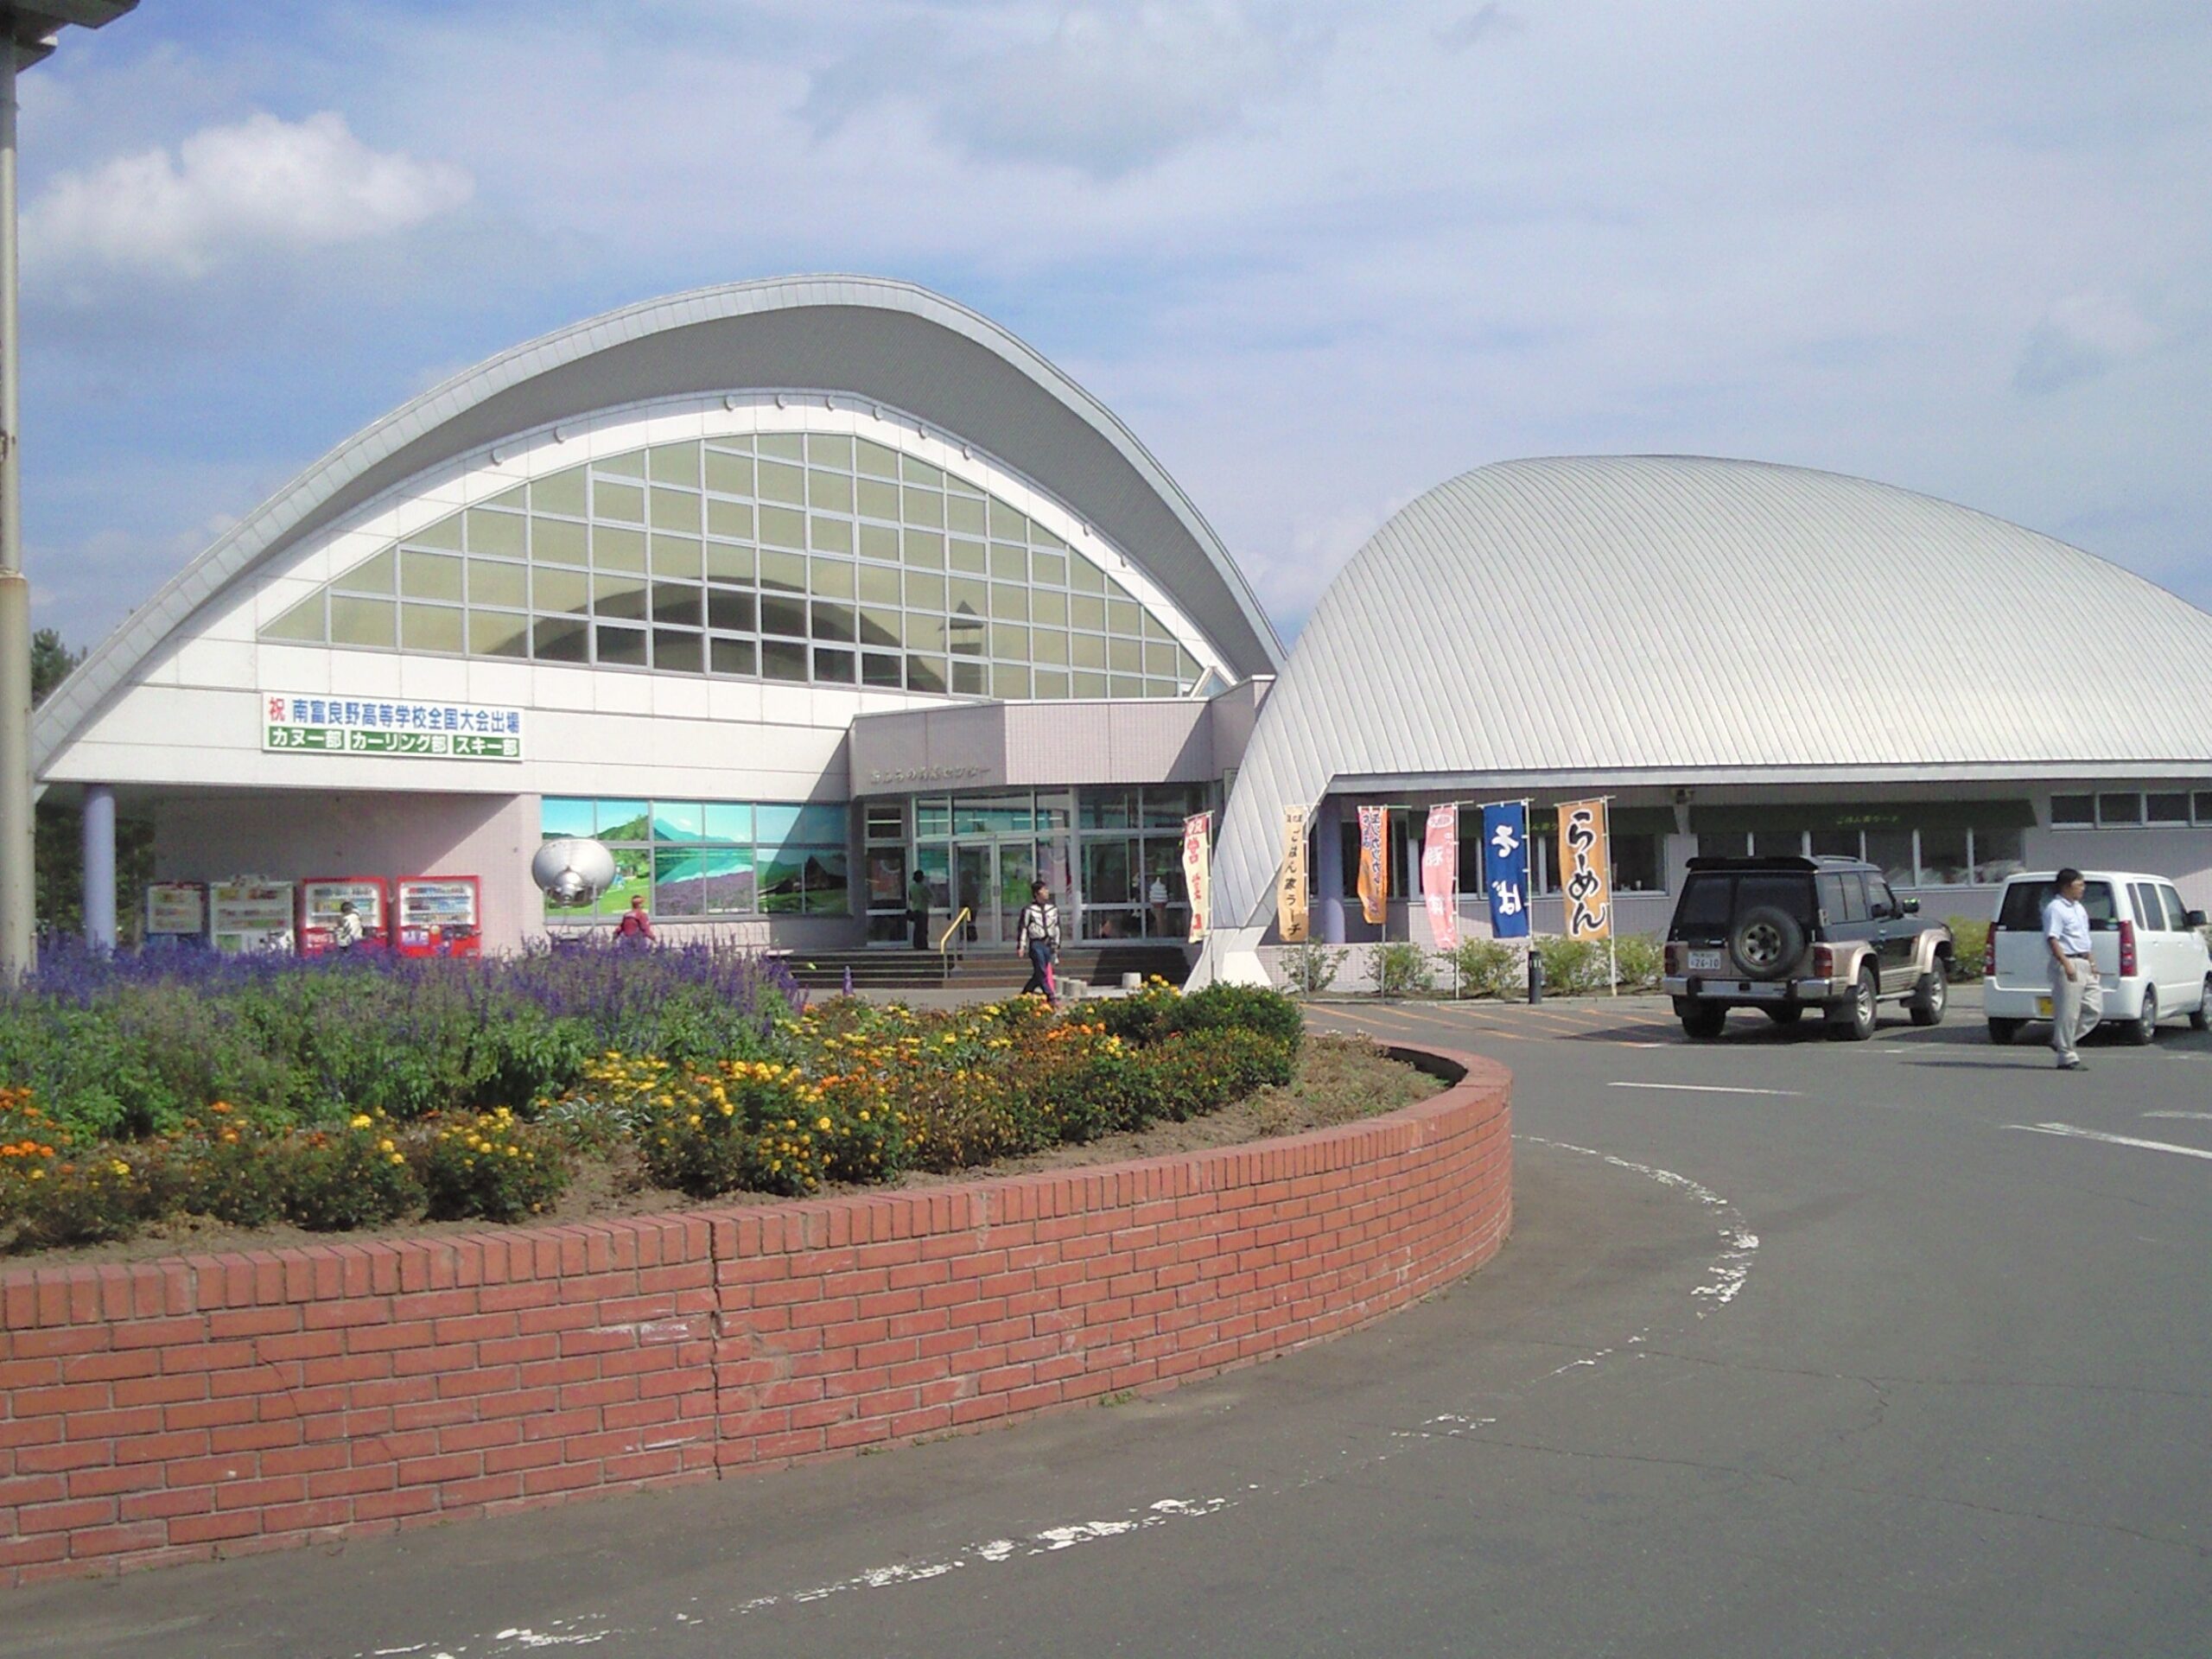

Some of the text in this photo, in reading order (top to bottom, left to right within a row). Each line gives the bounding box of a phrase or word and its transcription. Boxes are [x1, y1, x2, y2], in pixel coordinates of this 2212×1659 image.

[269, 696, 520, 734] 祝 南富良野高等学校全国大会出場
[272, 728, 519, 758] カヌー部 カーリング部 スキー部
[1567, 809, 1607, 937] らーめん
